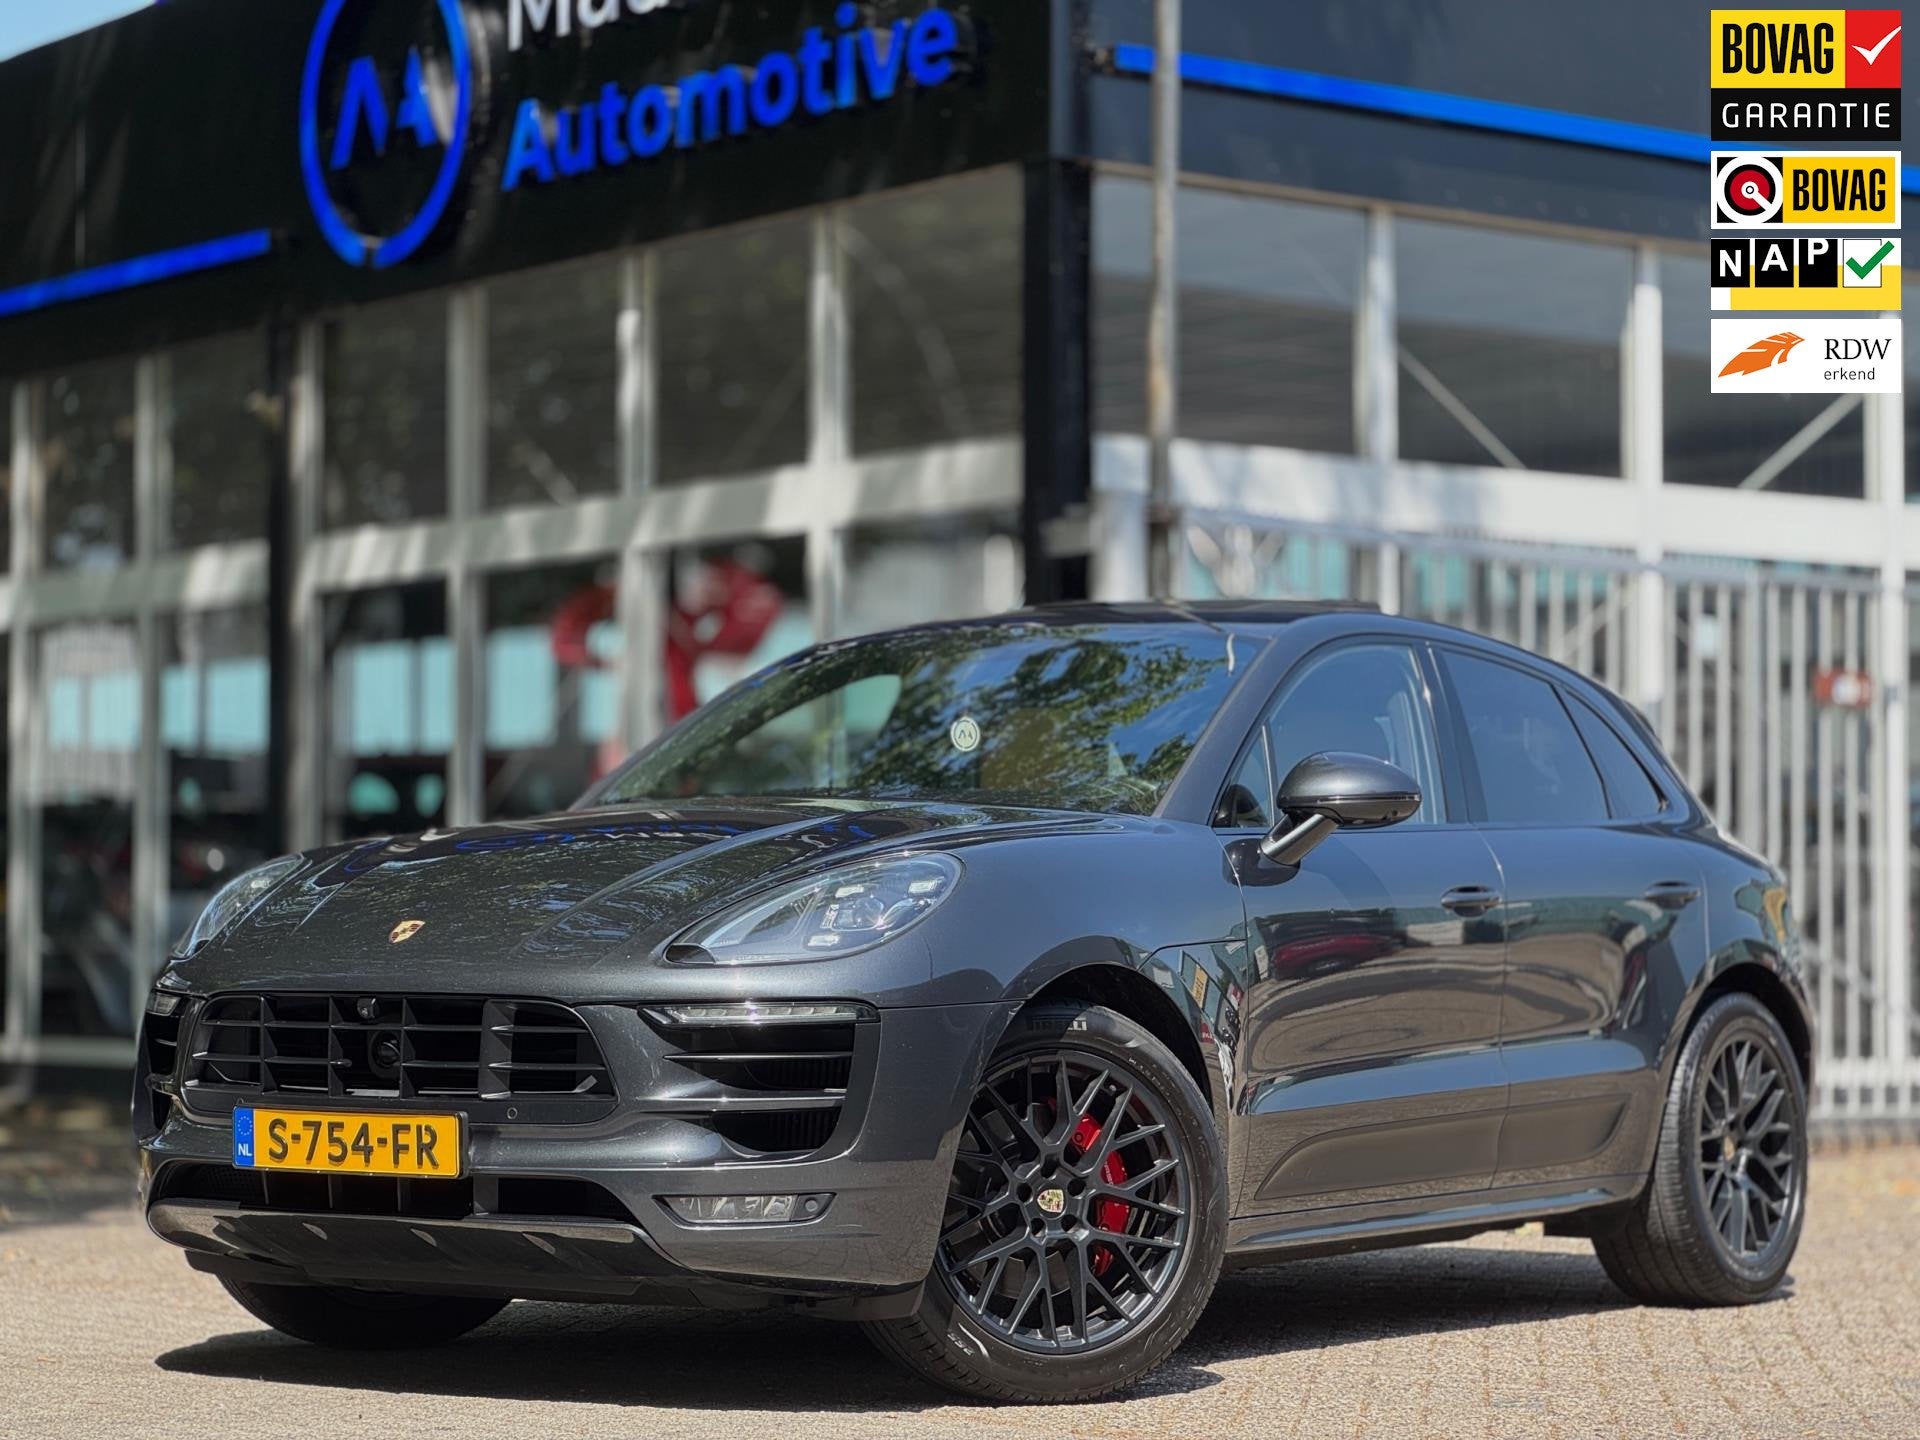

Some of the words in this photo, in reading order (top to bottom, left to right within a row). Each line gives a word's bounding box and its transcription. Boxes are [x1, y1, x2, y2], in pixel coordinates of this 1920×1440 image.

[502, 2, 959, 192] Automotive
[238, 1143, 253, 1157] NL
[268, 1117, 439, 1169] S-754-FR
